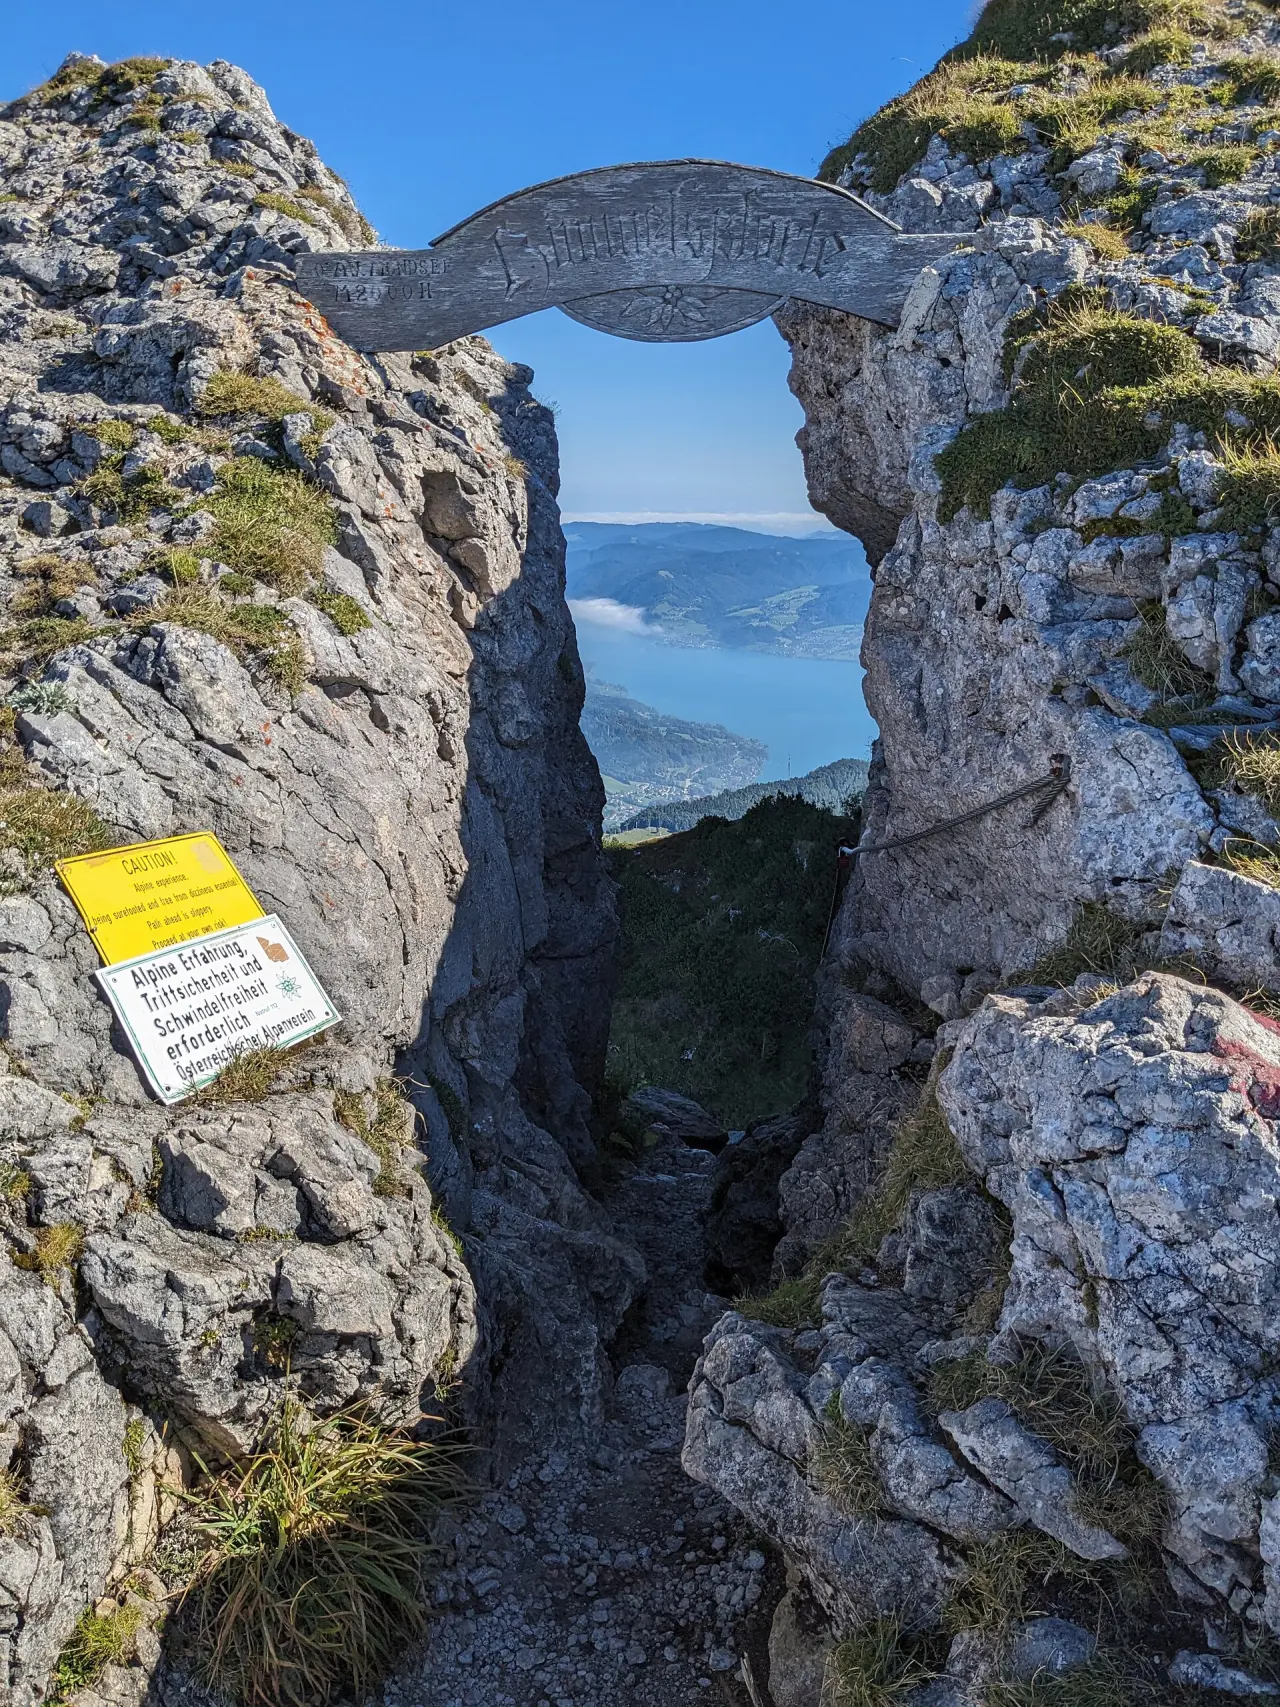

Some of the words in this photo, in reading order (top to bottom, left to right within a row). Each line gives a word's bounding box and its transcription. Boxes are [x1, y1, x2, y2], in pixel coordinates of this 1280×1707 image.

[122, 850, 178, 875] CAUTION!
[134, 880, 155, 894] Alpine
[92, 913, 113, 926] being
[113, 902, 147, 920] surefooted
[147, 899, 159, 910] and
[161, 896, 173, 906] free
[174, 892, 188, 902] from
[189, 884, 214, 898] dizziness
[214, 877, 240, 891] essential!
[146, 918, 162, 931] Path
[164, 913, 182, 926] ahead
[183, 911, 190, 919] is
[152, 933, 178, 950] Proceed
[179, 932, 187, 941] at
[187, 929, 200, 940] your
[202, 923, 214, 934] own
[214, 917, 228, 930] risk!
[130, 961, 179, 990] Alpine
[178, 940, 249, 974] Erfahrung,
[140, 965, 239, 1013] Trittsicherheit
[239, 955, 263, 979] und
[153, 978, 269, 1038] Schwindelfreiheit
[167, 1012, 251, 1062] erforderlich
[175, 1036, 264, 1081] Österreichischer
[262, 1008, 316, 1046] Alpenverein
